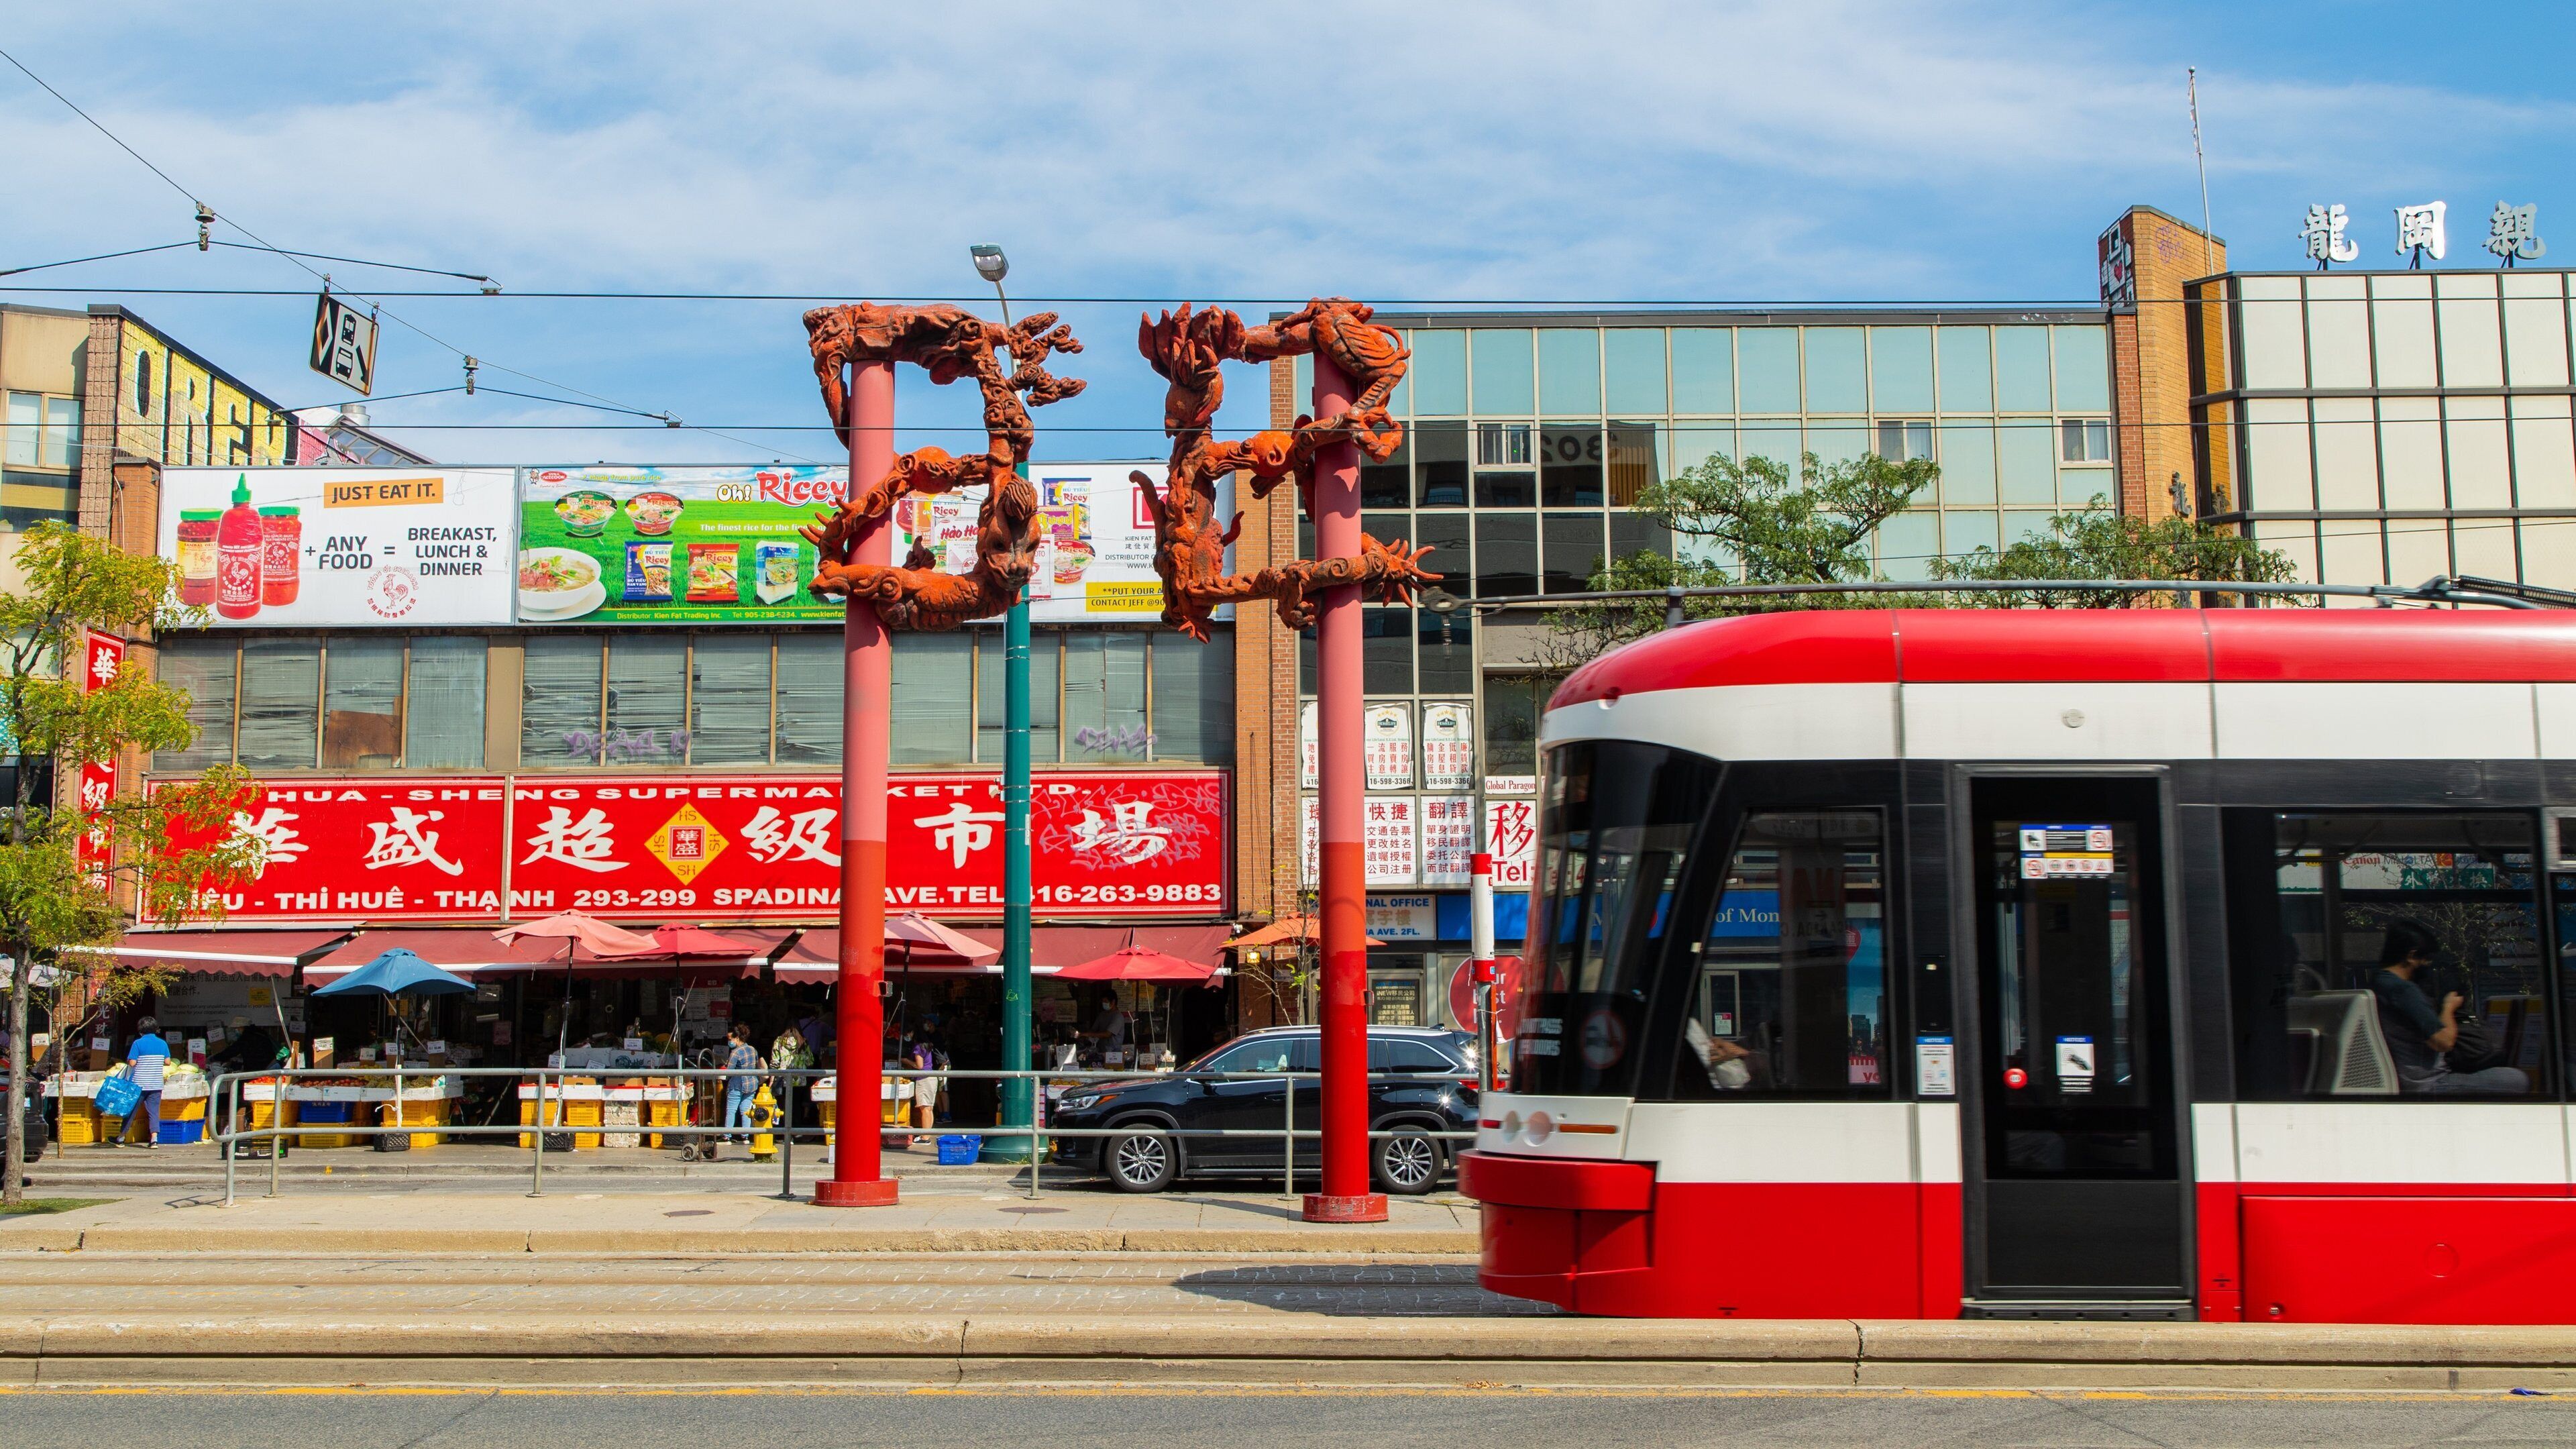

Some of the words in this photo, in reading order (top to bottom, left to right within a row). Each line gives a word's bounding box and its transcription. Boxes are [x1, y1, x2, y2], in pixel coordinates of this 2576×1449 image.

[630, 474, 646, 482] pure
[331, 486, 374, 504] JUST
[380, 484, 411, 499] EAT
[417, 482, 435, 498] IT.
[716, 484, 751, 502] Oh!
[755, 471, 849, 508] Ricey
[700, 524, 716, 532] The
[718, 523, 741, 532] finest
[744, 523, 759, 532] rice
[761, 523, 773, 532] for
[775, 523, 790, 532] the
[408, 527, 498, 542] BREAKAST,
[325, 536, 368, 552] ANY
[415, 545, 471, 558] LUNCH
[476, 545, 488, 558] &
[319, 553, 373, 570] FOOD
[420, 562, 483, 576] DINNER
[1128, 598, 1144, 607] JEFF
[684, 612, 709, 621] Trading
[1366, 742, 1409, 752] 一流服務
[1367, 753, 1409, 764] 買房賣房
[1368, 764, 1409, 774] 生意轉讓
[1485, 780, 1506, 790] Global
[1508, 780, 1536, 792] Paragon
[268, 790, 368, 802] HUA
[407, 788, 582, 802] SHENG
[596, 786, 973, 800] SUPERMAKET
[1369, 802, 1409, 821] 快捷
[1429, 802, 1468, 819] 翻譯
[1366, 825, 1411, 837] 交通告票
[1426, 824, 1471, 835] 單身證明
[1487, 800, 1535, 859] 移
[1367, 839, 1411, 849] 更改姓名
[1426, 837, 1471, 848] 移民翻譯
[1426, 850, 1471, 861] 委托公證
[2341, 855, 2381, 867] Canon
[1427, 863, 1471, 873] 面試翻譯
[574, 889, 696, 907] 293-299
[1030, 883, 1222, 903] 16-263-9883
[1390, 898, 1430, 908] OFFICE
[1715, 907, 1735, 923] of
[1738, 908, 1780, 923] Mon
